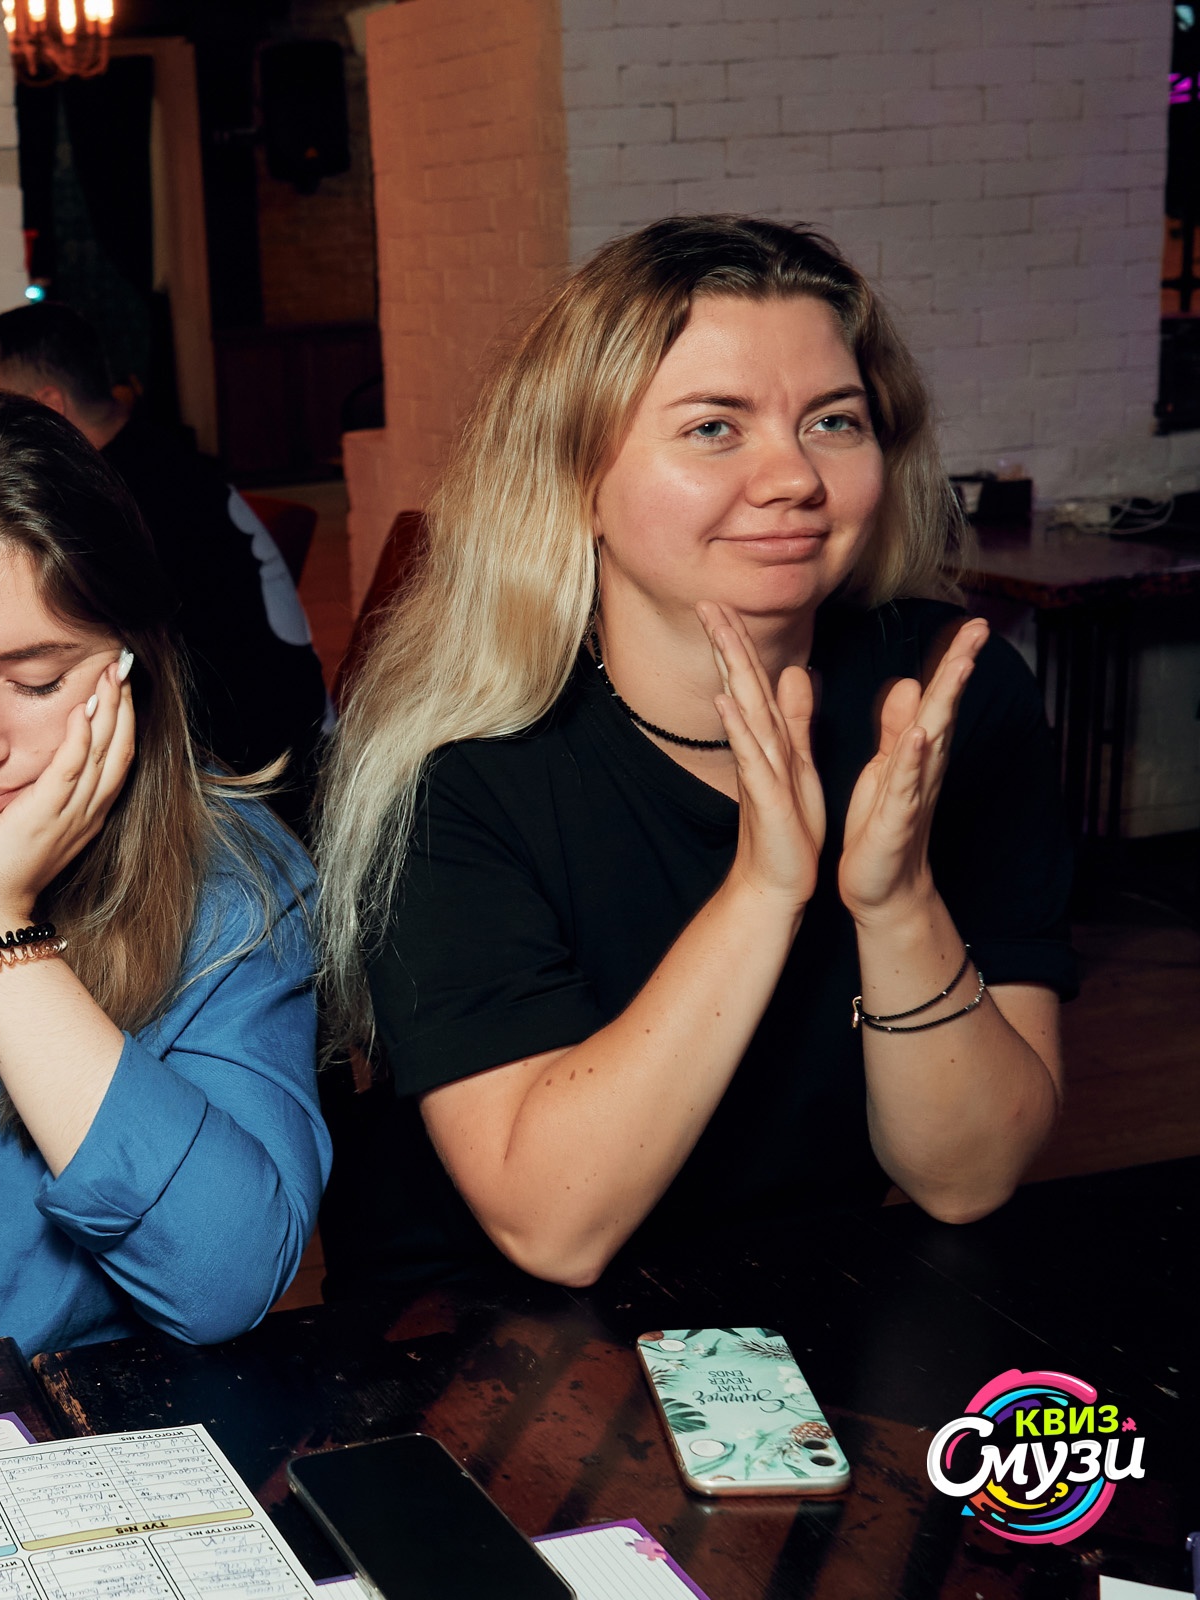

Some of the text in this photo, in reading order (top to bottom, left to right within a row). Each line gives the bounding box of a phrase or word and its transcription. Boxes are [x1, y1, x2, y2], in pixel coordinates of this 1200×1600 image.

[692, 1389, 785, 1413] Summer
[115, 1521, 168, 1534] ТУР №5
[224, 1523, 255, 1532] ИТОГО
[105, 1540, 138, 1549] ИТОГО
